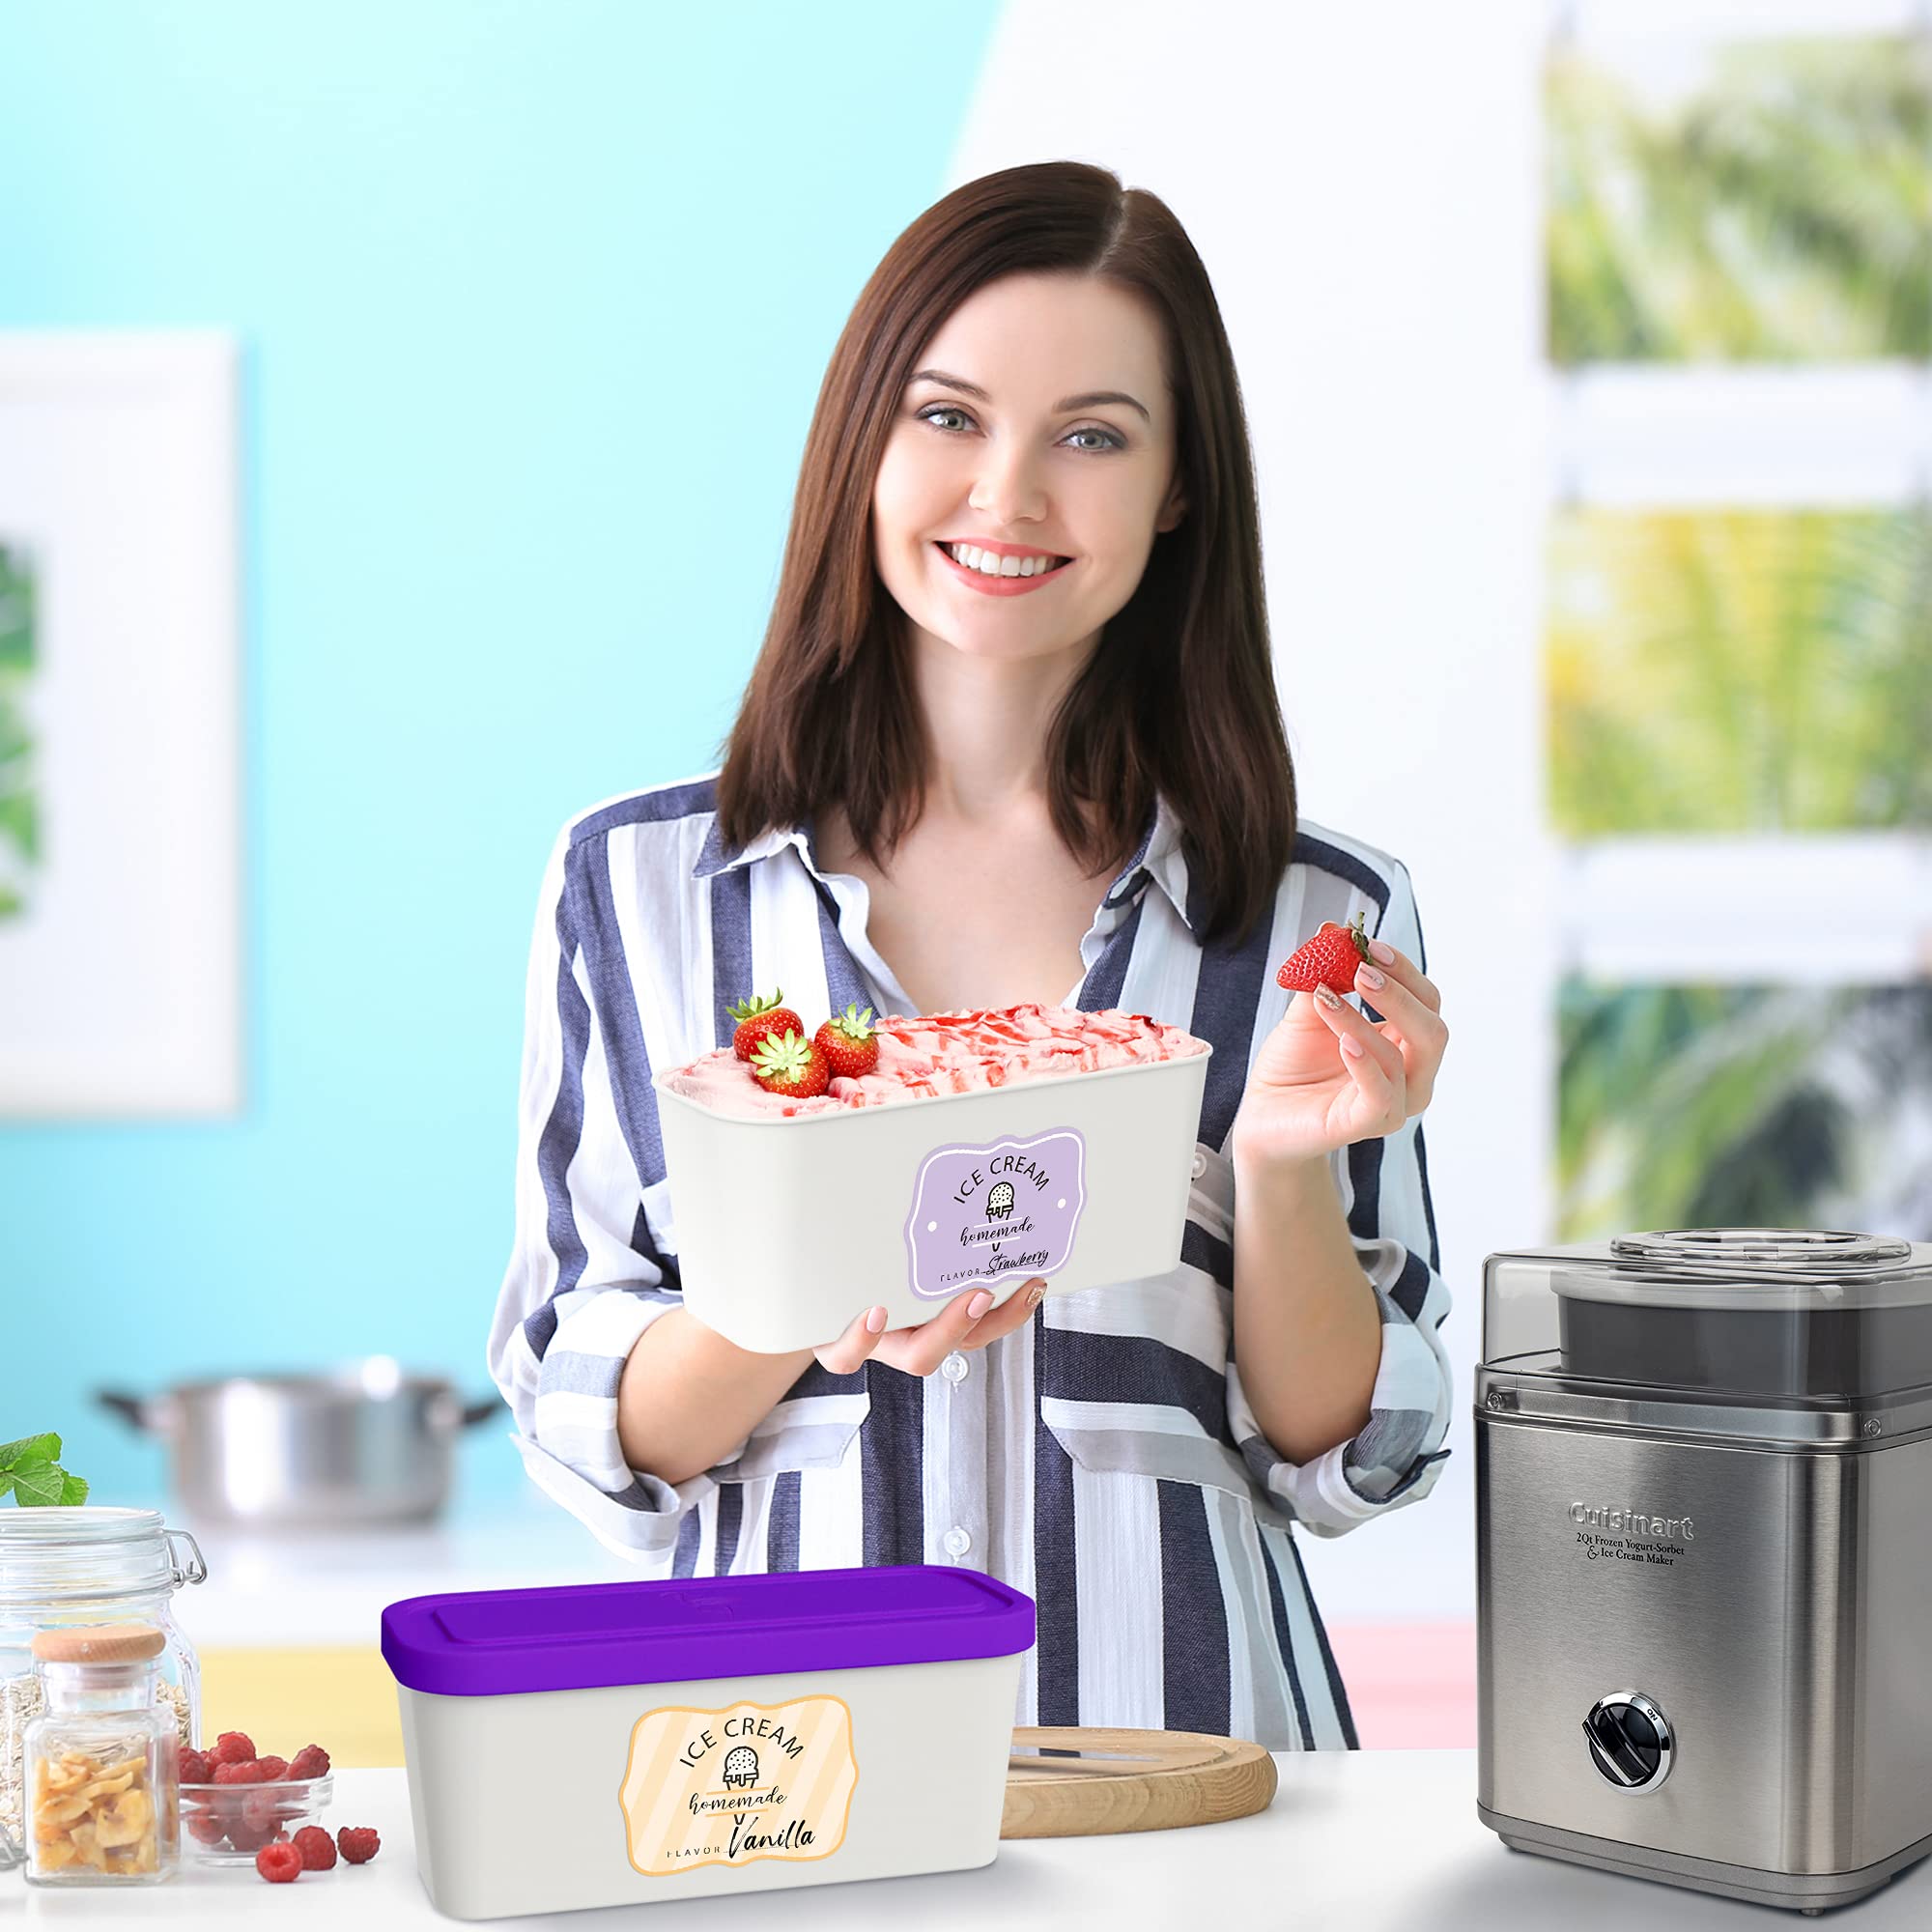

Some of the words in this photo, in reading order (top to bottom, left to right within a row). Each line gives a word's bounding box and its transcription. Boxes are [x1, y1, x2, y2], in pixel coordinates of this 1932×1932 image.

[953, 1169, 984, 1204] ICE
[989, 1155, 1050, 1192] CREAM
[960, 1215, 1035, 1246] homemade
[986, 1249, 1049, 1275] Strawberry
[1569, 1501, 1694, 1541] Cuisinart
[1577, 1532, 1593, 1545] 2Qt
[1595, 1534, 1623, 1548] Frozen
[1625, 1538, 1685, 1555] Yogurt-Sorbet
[1586, 1546, 1600, 1560] &
[1601, 1548, 1614, 1558] Ice
[1615, 1548, 1644, 1562] Cream
[1646, 1552, 1674, 1566] Maker
[1646, 1708, 1659, 1721] ON
[679, 1729, 718, 1768] ICE
[724, 1717, 805, 1760] CREAM
[689, 1785, 787, 1815] homemade
[728, 1816, 816, 1859] Vanilla
